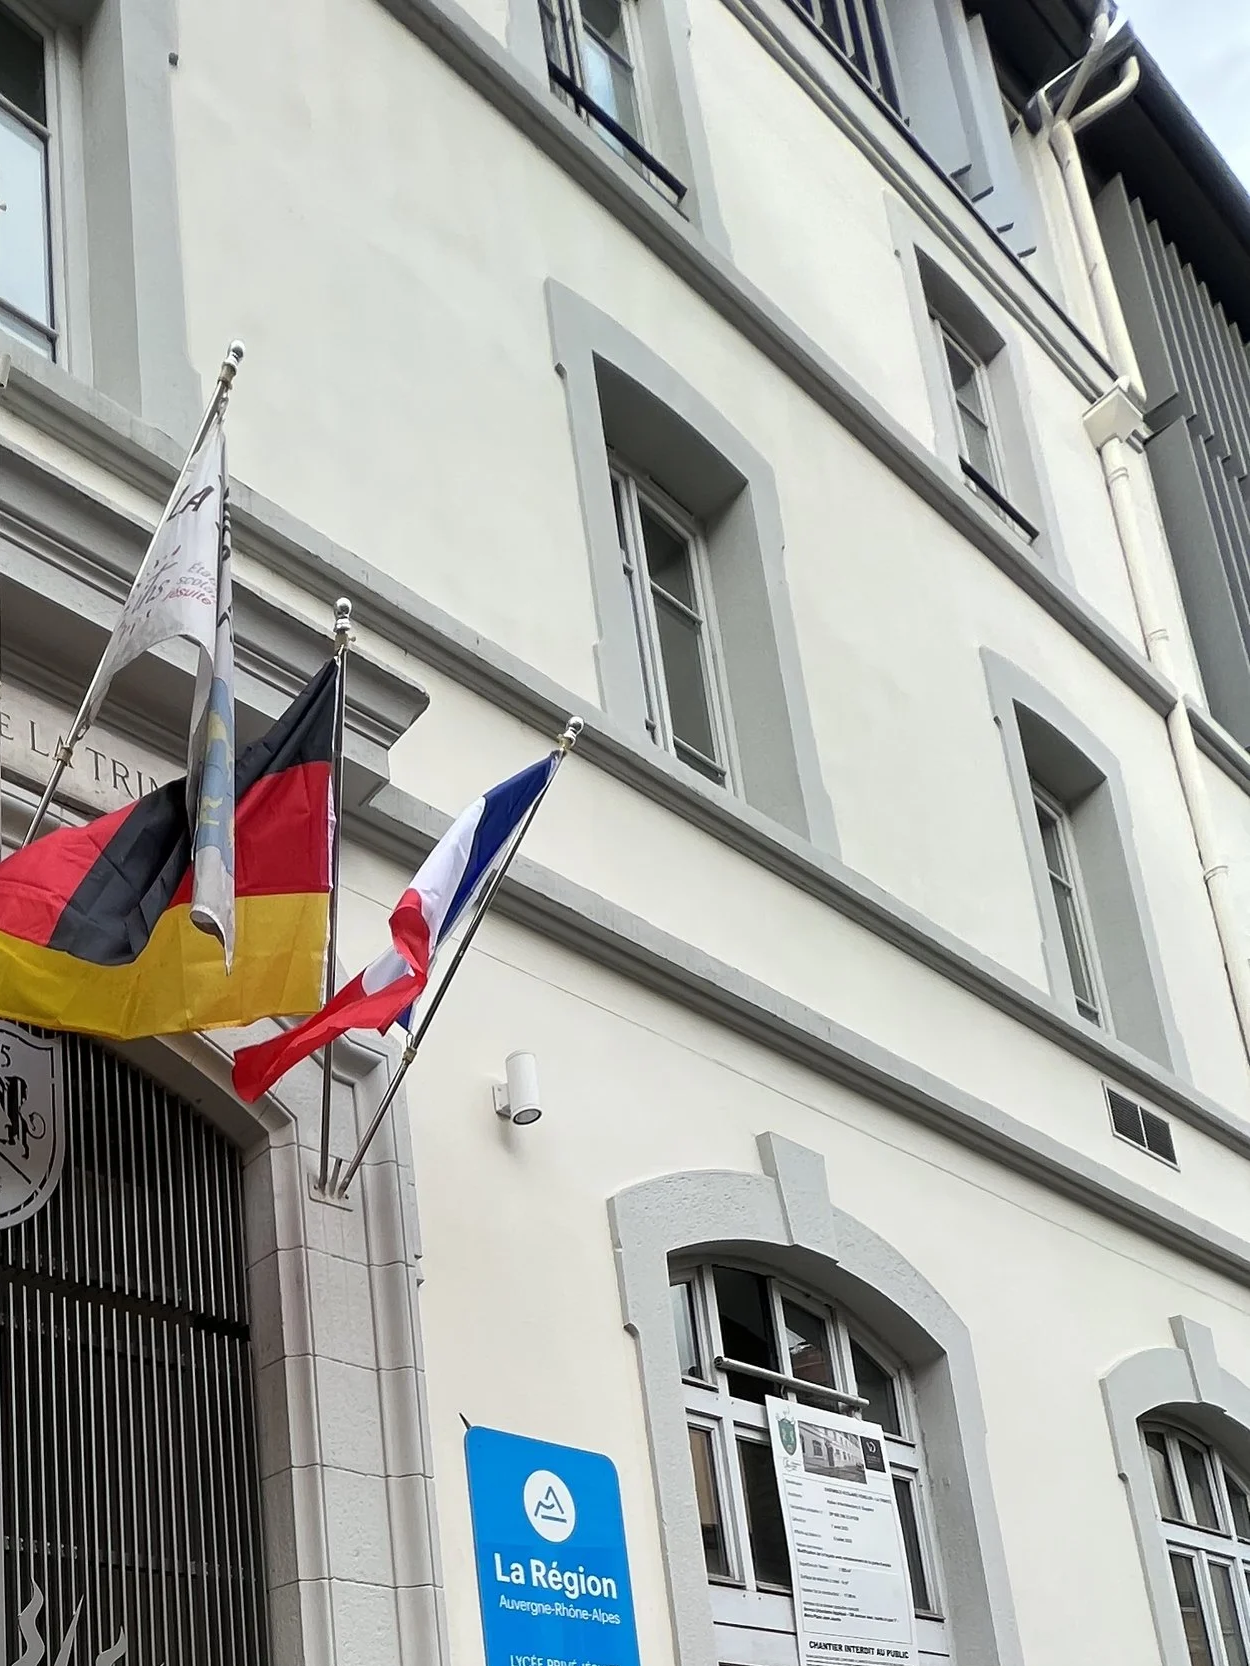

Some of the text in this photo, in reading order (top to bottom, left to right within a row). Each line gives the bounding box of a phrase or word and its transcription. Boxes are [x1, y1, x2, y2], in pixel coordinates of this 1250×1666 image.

[494, 1552, 618, 1600] La Région
[499, 1594, 621, 1625] Auvergne-Rhône-Alpes
[808, 1640, 910, 1659] CHANTIER INTERDIT AU PUBLIC
